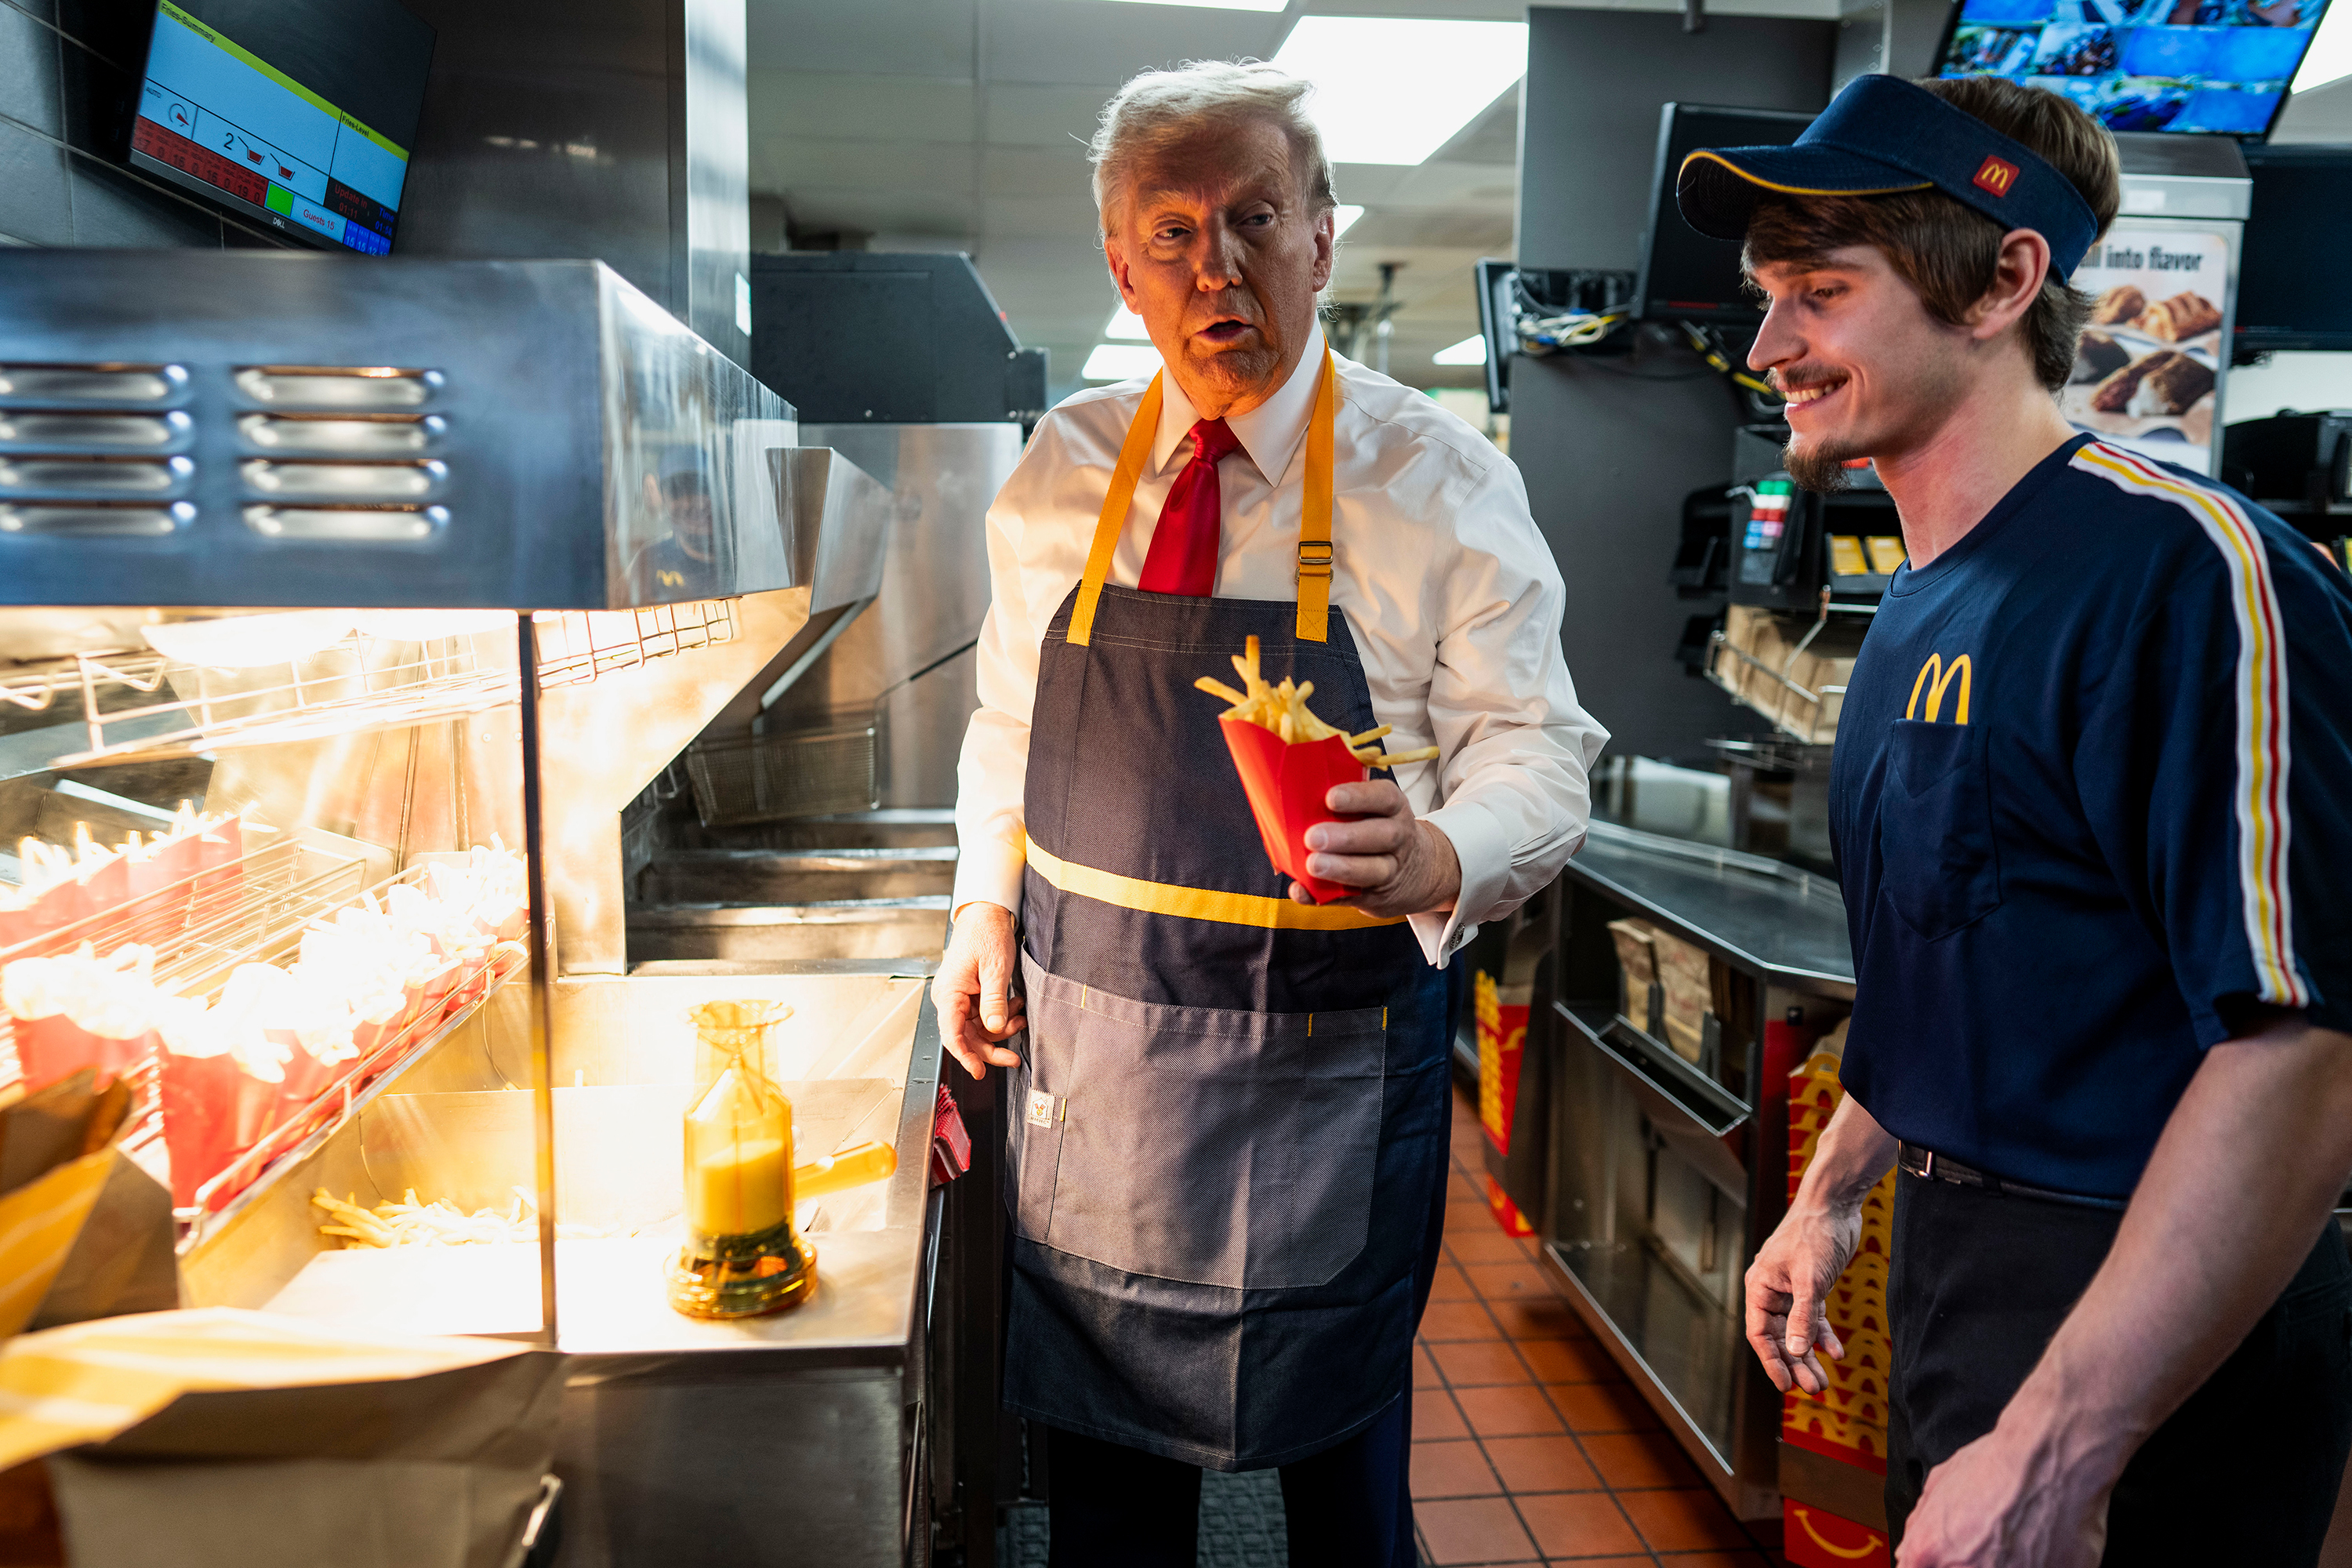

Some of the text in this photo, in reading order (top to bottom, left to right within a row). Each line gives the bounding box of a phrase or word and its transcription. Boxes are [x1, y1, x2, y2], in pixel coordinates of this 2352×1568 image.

[161, 2, 216, 43] Fries-Summary
[342, 115, 369, 137] Fries-Level
[223, 132, 234, 151] 2
[224, 178, 230, 189] 0
[238, 184, 249, 198] 19
[254, 192, 260, 203] 0
[335, 184, 368, 209] Update in
[303, 209, 325, 227] Guests
[339, 202, 358, 219] 01:11
[379, 207, 394, 223] Time
[272, 217, 285, 229] DELL
[2078, 245, 2205, 271] all into flavor
